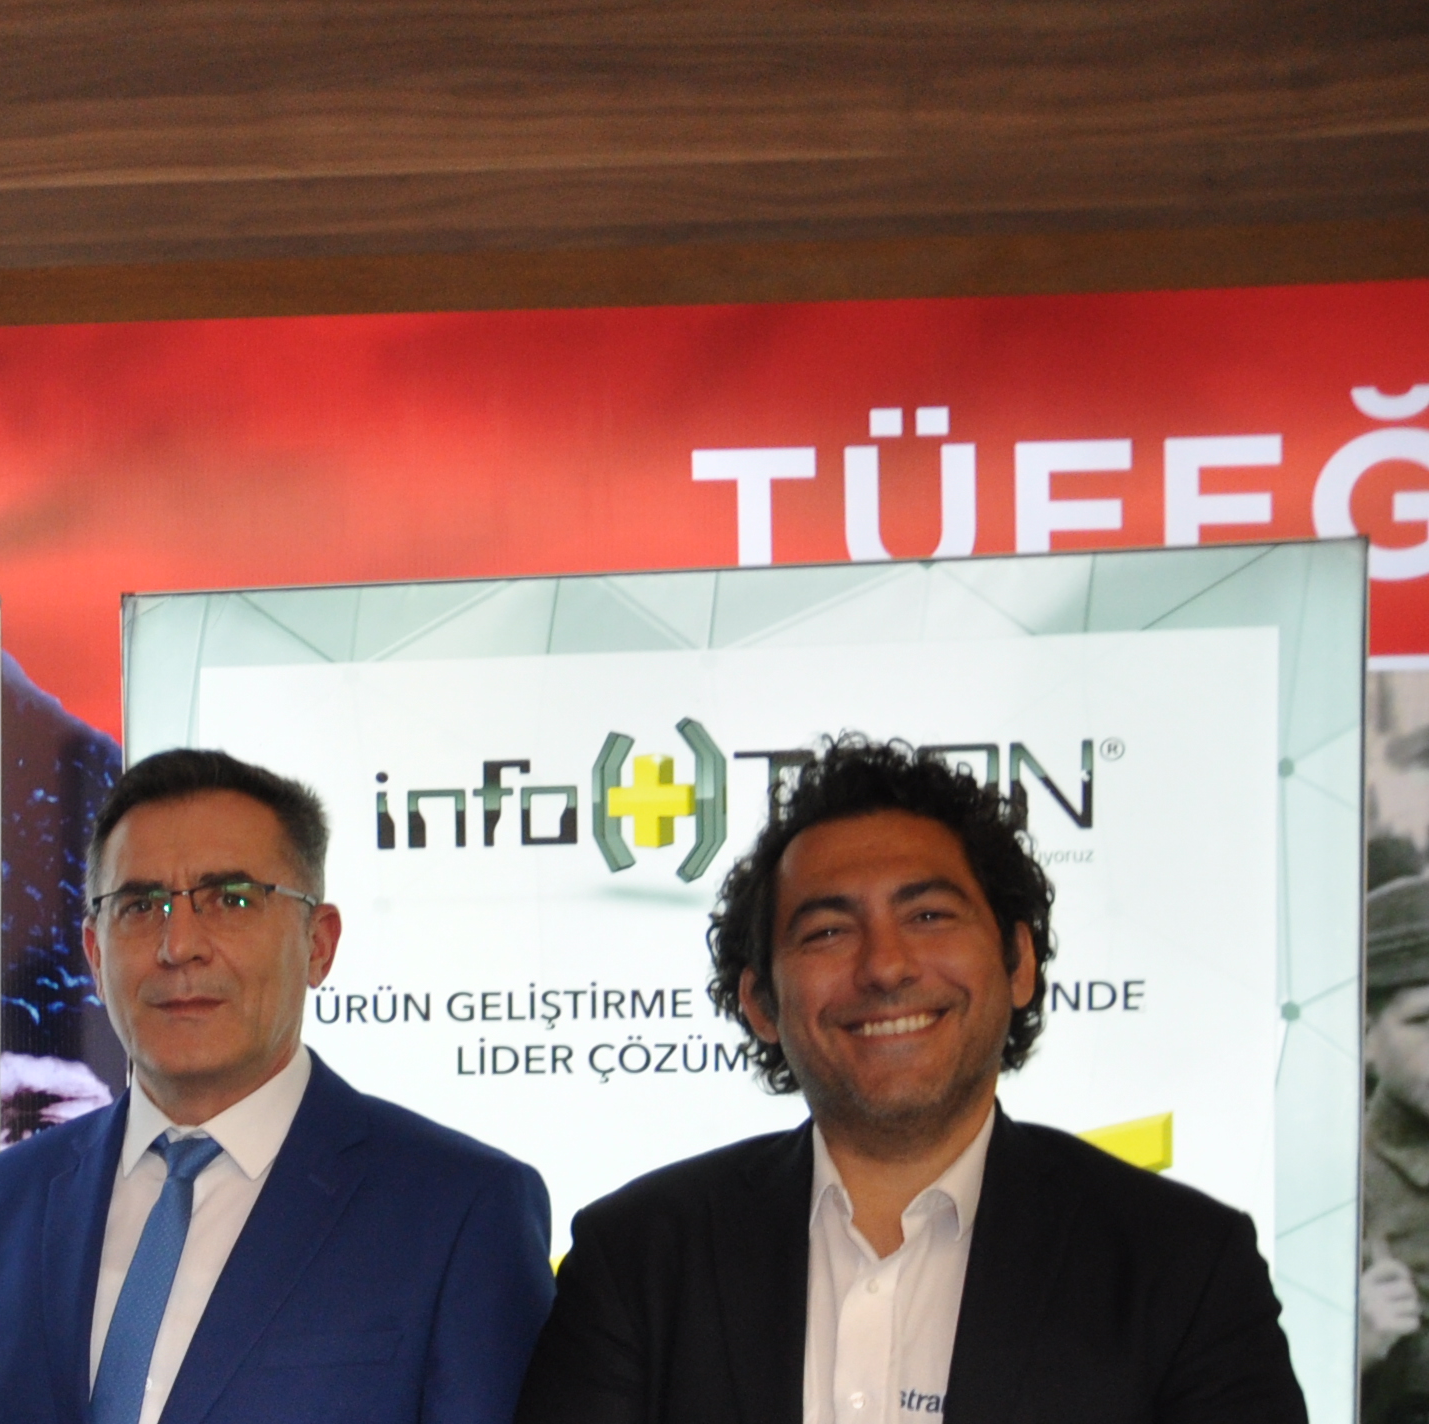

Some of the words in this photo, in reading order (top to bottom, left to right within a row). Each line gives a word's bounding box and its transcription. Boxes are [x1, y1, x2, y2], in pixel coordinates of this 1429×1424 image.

[313, 984, 431, 1024] ÜRÜN
[446, 981, 695, 1028] GELİŞTİRME
[456, 1035, 574, 1077] LİDER
[588, 1033, 750, 1085] ÇÖZÜM
